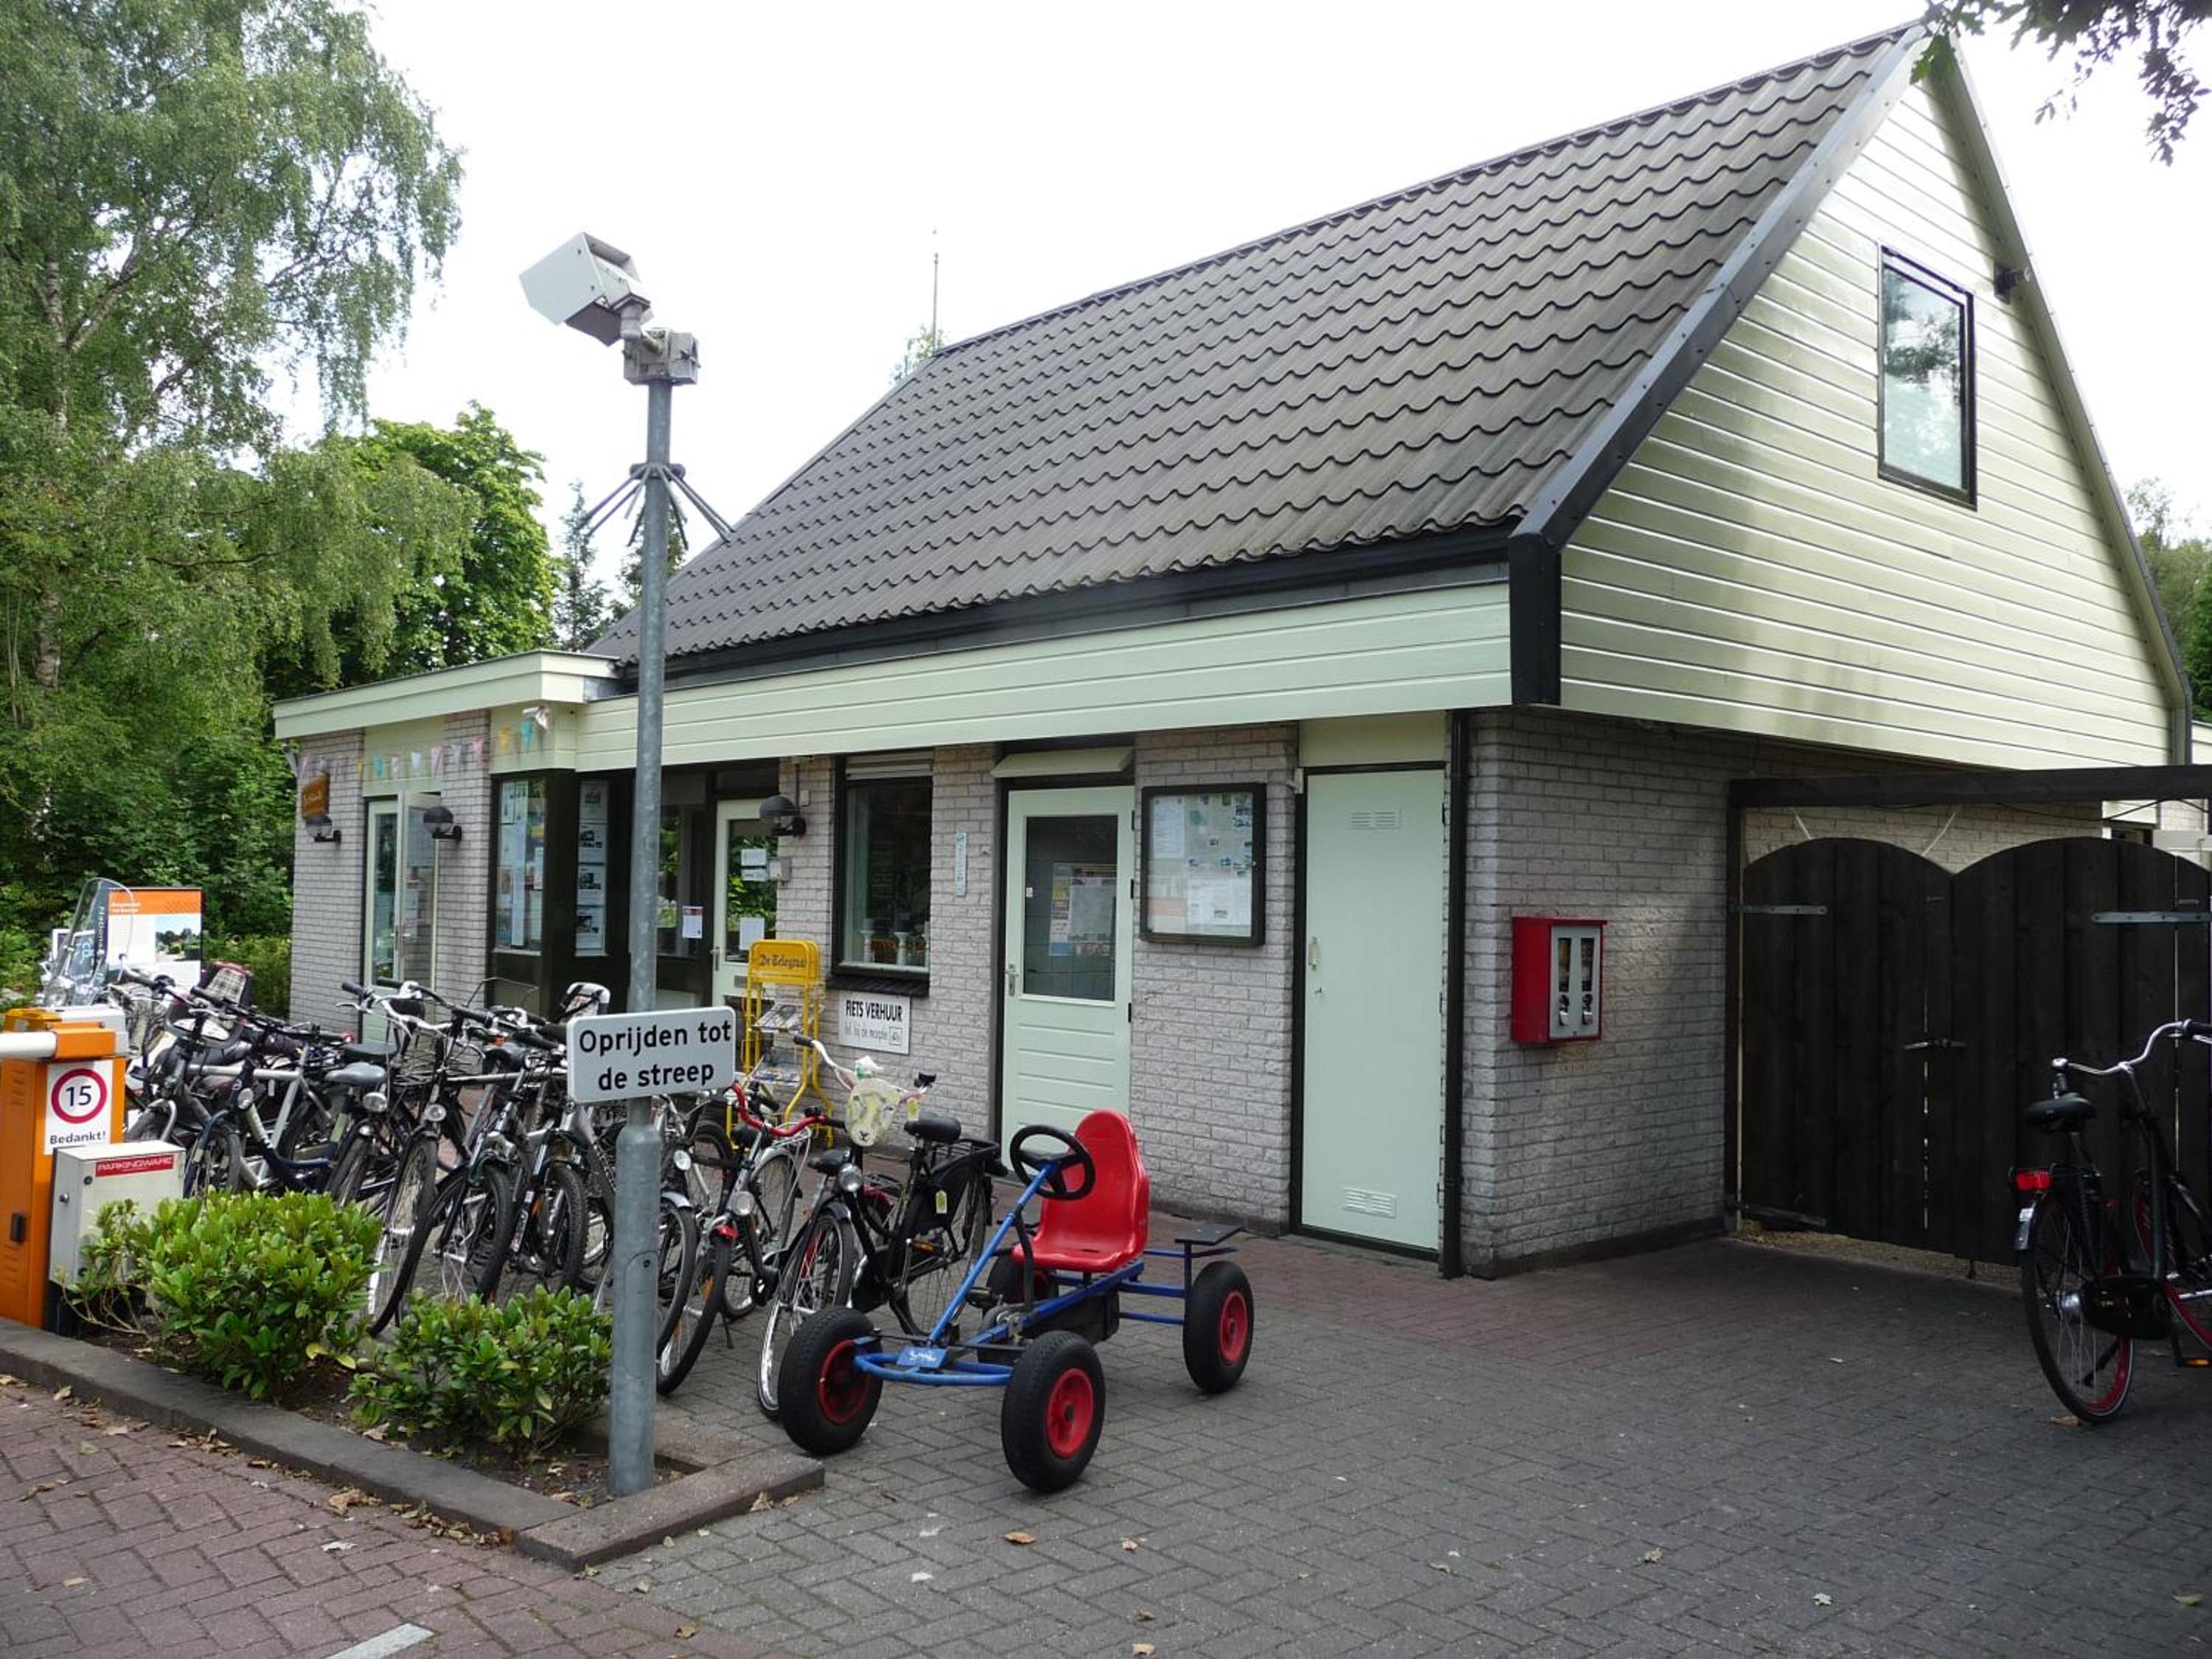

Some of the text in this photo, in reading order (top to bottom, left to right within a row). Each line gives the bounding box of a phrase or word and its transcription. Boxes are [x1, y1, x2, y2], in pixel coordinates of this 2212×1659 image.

[865, 1002, 903, 1022] VERHUUR
[579, 1020, 732, 1057] Oprijden tot
[598, 1063, 714, 1091] de streep
[65, 1085, 93, 1107] 15
[49, 1130, 106, 1145] Bedankt!
